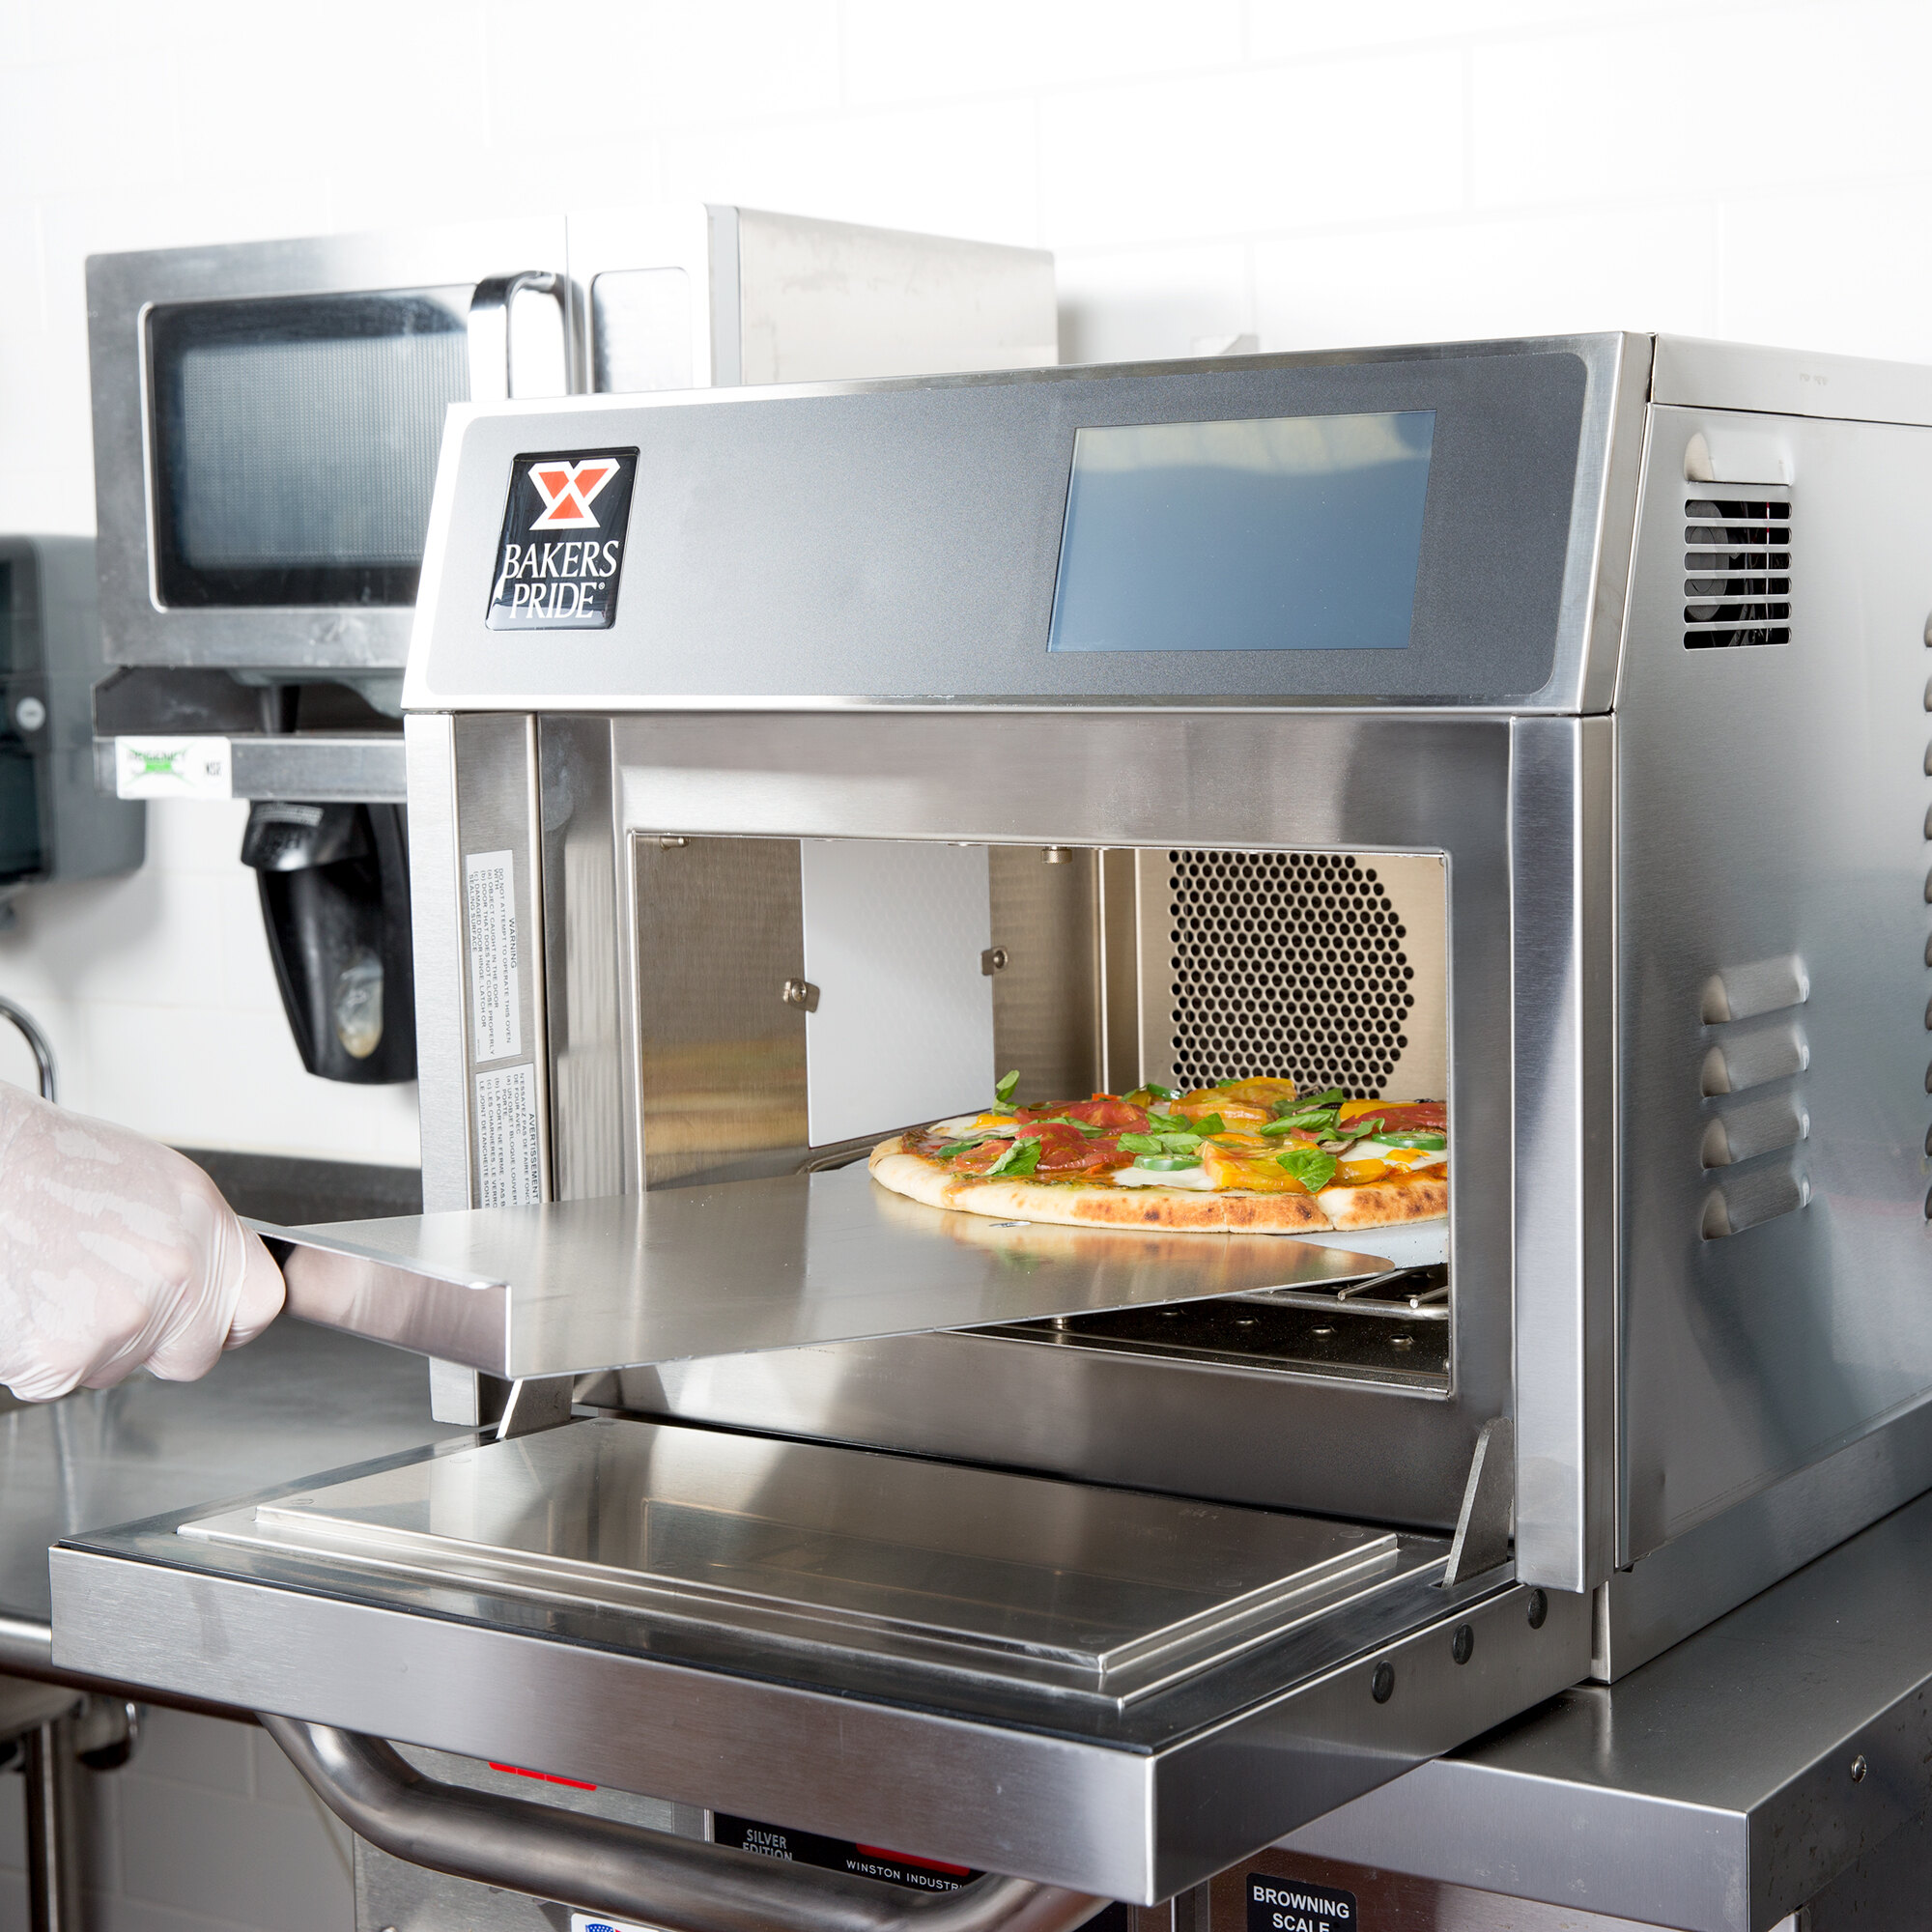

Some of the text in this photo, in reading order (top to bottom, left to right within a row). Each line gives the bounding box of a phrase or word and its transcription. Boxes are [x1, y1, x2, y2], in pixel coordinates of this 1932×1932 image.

[501, 540, 619, 580] BAKERS
[498, 868, 503, 880] DO
[502, 944, 507, 955] TO
[481, 1015, 486, 1027] OR
[514, 1074, 518, 1084] DE
[480, 1081, 484, 1091] LE
[496, 1091, 500, 1101] LA
[507, 1088, 512, 1099] UN
[497, 1133, 502, 1145] NE
[523, 1138, 527, 1149] DE
[528, 1113, 538, 1198] AVERTISSEMENT
[492, 1167, 496, 1177] LE
[747, 1829, 787, 1849] SILVER
[846, 1860, 901, 1880] WINSTON
[1253, 1886, 1350, 1918] BROWNING
